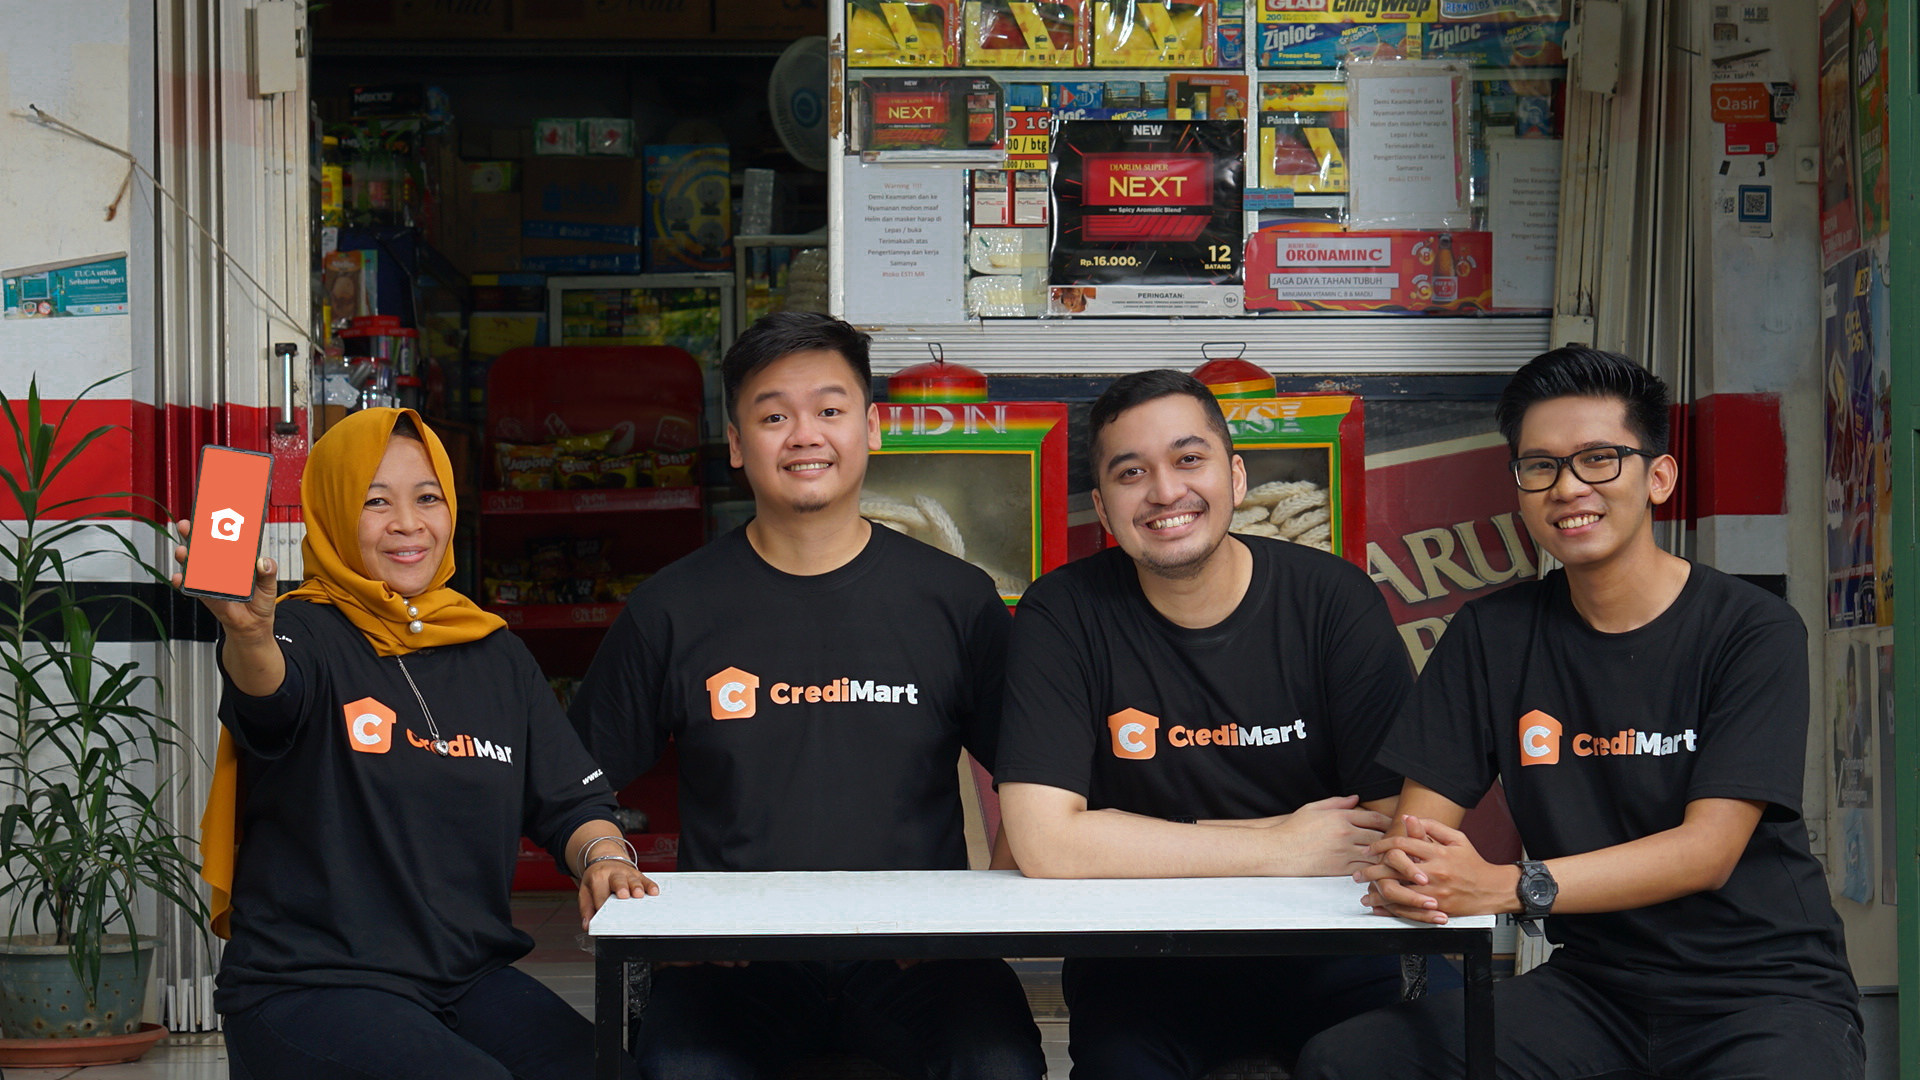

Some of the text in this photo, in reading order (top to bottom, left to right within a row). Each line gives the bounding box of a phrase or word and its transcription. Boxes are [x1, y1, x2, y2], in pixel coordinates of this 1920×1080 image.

[1262, 24, 1317, 51] Ziploc
[1428, 23, 1482, 50] Ziploc
[1858, 39, 1879, 87] FANTA
[1716, 95, 1760, 111] Qasir
[888, 106, 934, 119] NEXT
[1026, 116, 1049, 130] 16
[1132, 124, 1163, 136] NEW
[1030, 137, 1048, 154] btg
[1143, 163, 1169, 171] SUPER
[884, 183, 910, 191] Warning
[1109, 176, 1188, 198] NEXT
[1118, 206, 1134, 214] Spicy
[867, 249, 911, 257] Pengertiannya
[924, 249, 939, 257] kerja
[1207, 245, 1231, 263] 12
[1079, 255, 1142, 269] Rp.16.000,-
[1204, 263, 1231, 271] BATANG
[1271, 276, 1383, 286] JAGA DAYA TAHAN TUBUH
[217, 517, 237, 537] C
[1367, 511, 1546, 604] ARU
[719, 677, 919, 713] C CrediMart
[352, 713, 514, 767] C CrdiMar
[1118, 717, 1308, 753] C CrediMart
[1523, 725, 1699, 758] C CrediMart
